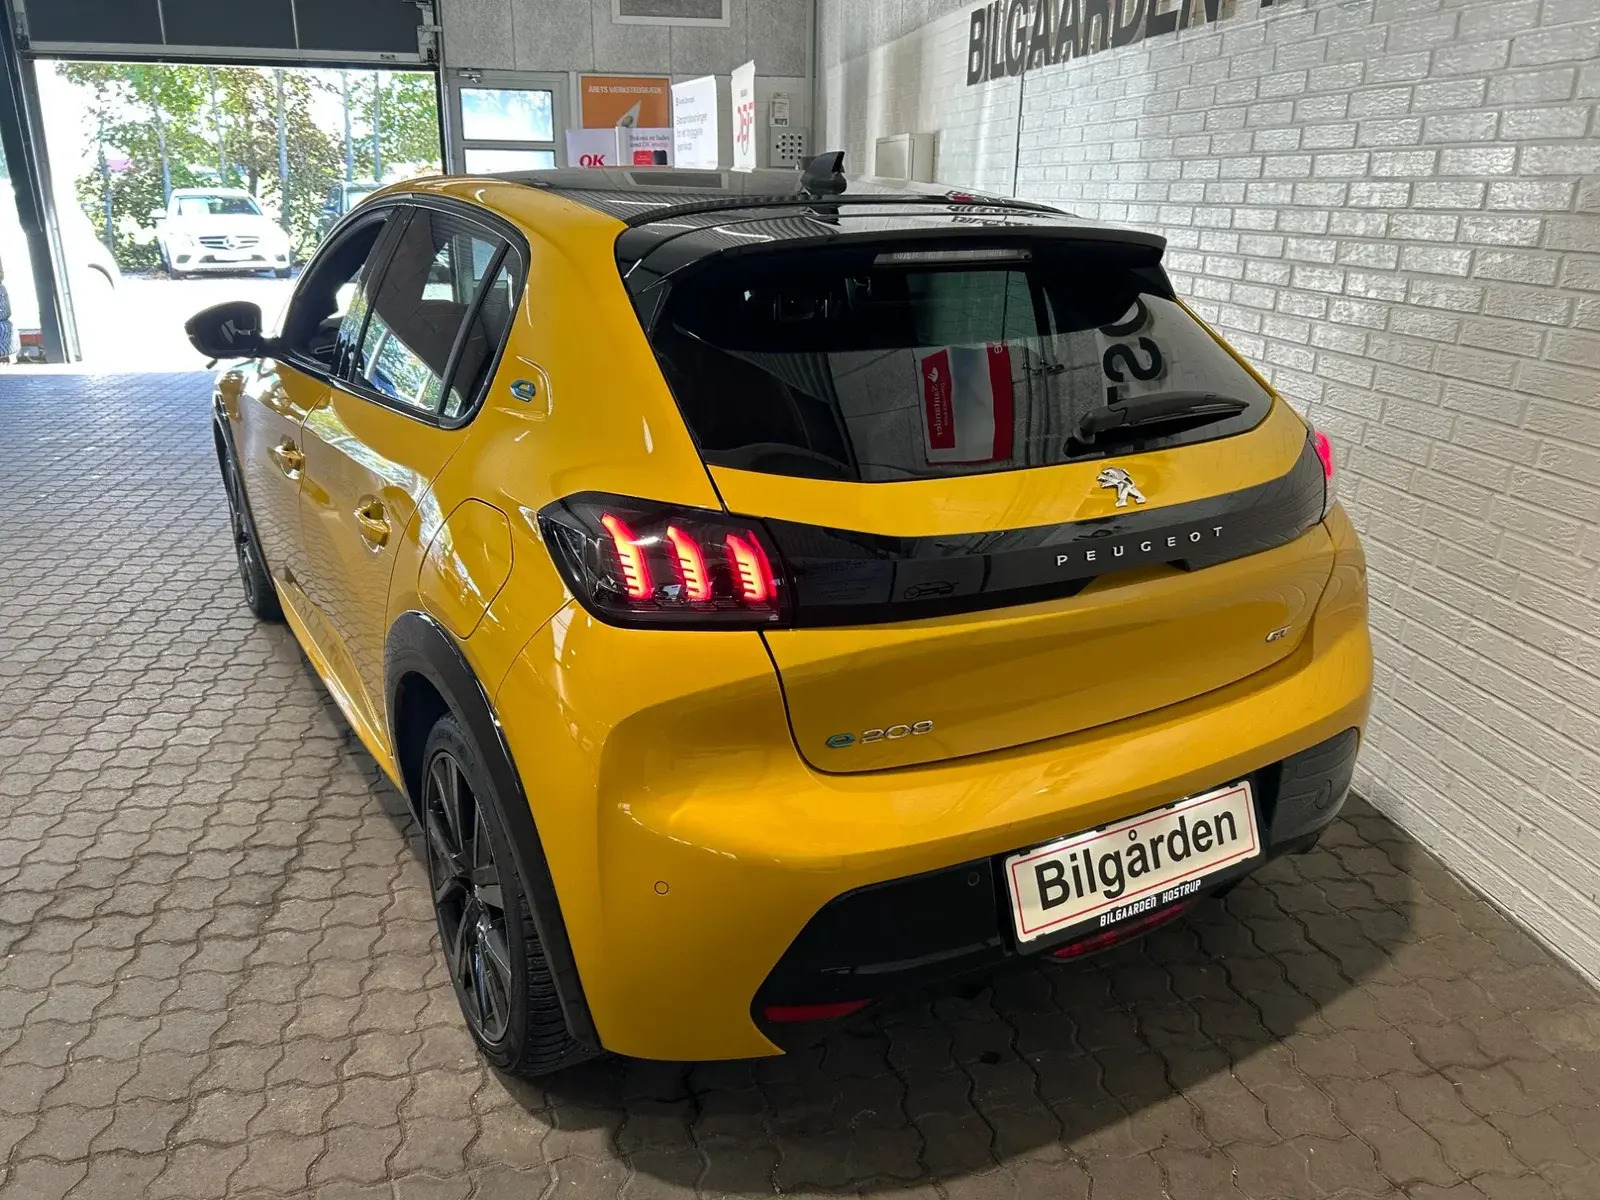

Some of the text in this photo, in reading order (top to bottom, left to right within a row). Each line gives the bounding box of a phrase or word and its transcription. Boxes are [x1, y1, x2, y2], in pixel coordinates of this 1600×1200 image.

[579, 154, 606, 167] OK
[1056, 526, 1223, 566] PEUGEOT
[1265, 625, 1291, 643] GT
[860, 720, 933, 744] 208
[1034, 810, 1237, 911] Bilgården
[1099, 879, 1201, 927] BILGAARDEN HOSTRUP
